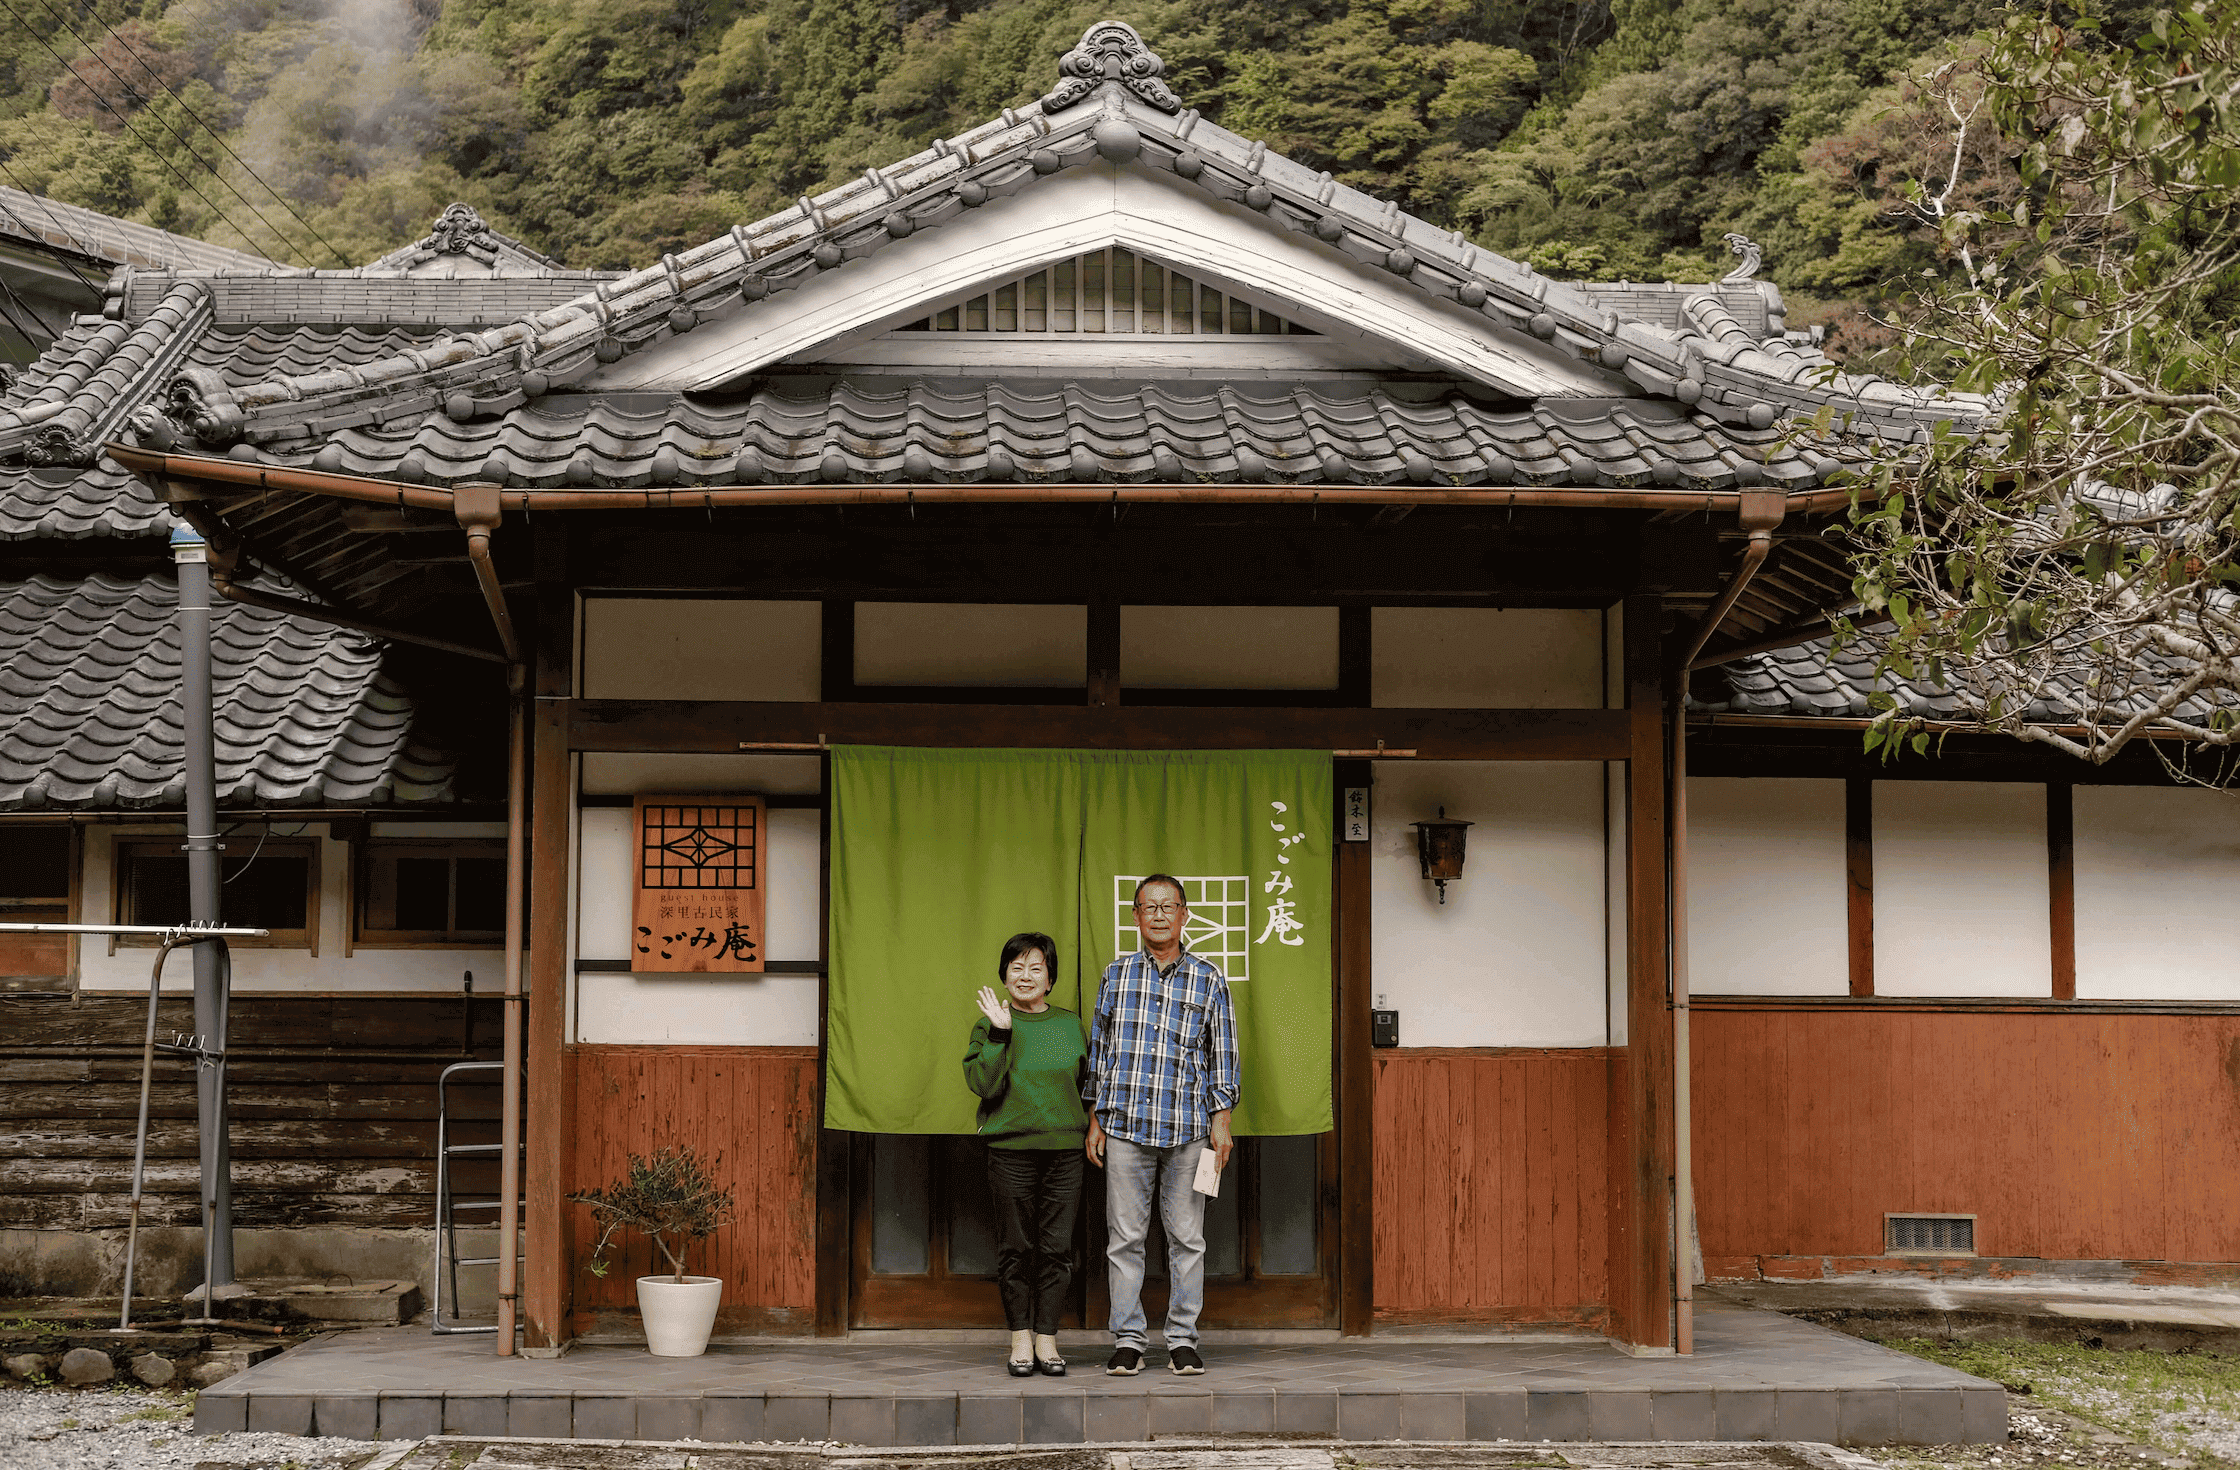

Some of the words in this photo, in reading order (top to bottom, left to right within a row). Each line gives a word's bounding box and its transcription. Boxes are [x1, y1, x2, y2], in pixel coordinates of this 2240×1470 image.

[1253, 801, 1305, 946] こごみ庵
[660, 894, 694, 903] guest
[702, 893, 739, 902] house
[660, 906, 739, 919] 深里古民家
[637, 922, 757, 962] こごみ庵
